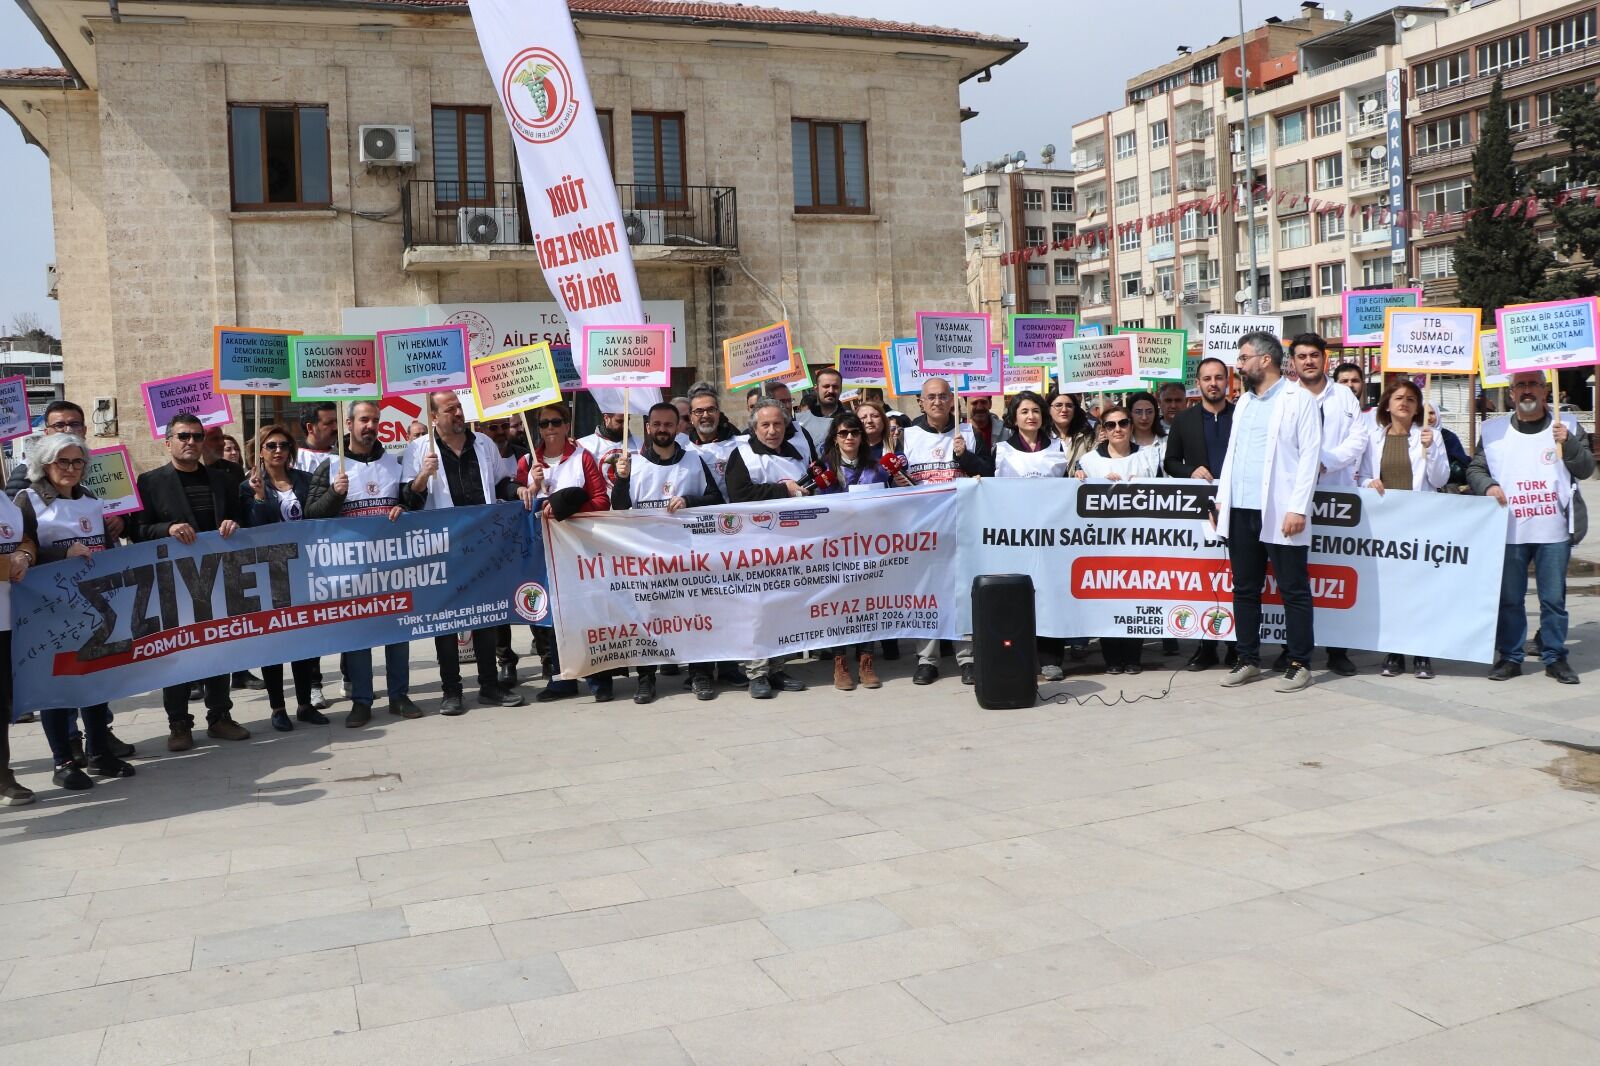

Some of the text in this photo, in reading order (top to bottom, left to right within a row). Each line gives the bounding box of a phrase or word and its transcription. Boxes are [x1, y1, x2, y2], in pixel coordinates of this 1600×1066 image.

[1539, 312, 1551, 321] BİR
[1572, 318, 1586, 327] BİR
[1209, 323, 1241, 334] SAĞLIK
[1423, 318, 1441, 328] TTB
[225, 337, 258, 346] AKADEMİK
[503, 330, 538, 346] AİLE
[635, 335, 648, 344] BİR
[1410, 331, 1453, 341] SUSMADI
[1514, 329, 1584, 344] HEKİMLİK ORTAMI
[398, 336, 449, 350] İYİ HEKİMLİK
[936, 344, 973, 353] İSTİYORUZ!
[1079, 343, 1113, 351] HALKLARIN
[1531, 341, 1567, 352] MÜMKÜN
[234, 347, 273, 356] DEMOKRATİK
[304, 346, 367, 356] SAĞLIĞIN YOLU
[598, 348, 619, 356] HALK
[905, 346, 916, 355] İYİ
[1396, 344, 1465, 355] SUSMAYACAK
[231, 356, 251, 364] ÖZERK
[407, 351, 442, 361] YAPMAK
[306, 358, 366, 368] DEMOKRASİ VE
[404, 361, 447, 374] İSTİYORUZ
[497, 357, 529, 370] DAKİKADA
[602, 359, 651, 367] SORUNUDUR
[1083, 360, 1112, 368] HAKKININ
[480, 370, 509, 385] HEKİMLİK
[501, 374, 534, 389] DAKİKADA
[199, 381, 210, 390] DE
[518, 382, 541, 393] OLMAZ
[161, 391, 213, 409] BEDENİMİZ DE
[1517, 479, 1548, 491] TÜRK
[1085, 489, 1202, 514] EMEĞİMİZ,
[1514, 504, 1557, 518] BİRLİĞİ
[305, 527, 449, 568] YÖNETMELİĞİNİ
[982, 523, 1469, 568] HALKIN SAĞLIK HAKKI, EMOKRASİ İÇİN
[577, 531, 938, 580] İYİ HEKİMLİK YAPMAK İSTİYORUZ!
[610, 580, 648, 592] ADALETİN
[650, 577, 679, 589] HAKİM
[682, 573, 720, 586] OLDUĞU,
[722, 571, 744, 583] LAİK,
[746, 566, 804, 582] DEMOKRATİK,
[832, 561, 860, 573] İÇİNDE
[864, 559, 877, 569] BİR
[880, 556, 909, 568] ÜLKEDE
[1080, 569, 1203, 591] ANKARA'YA
[309, 561, 448, 602] İSTEMİYORUZ!
[634, 569, 884, 602] EMEĞİMİZİN VE MESLEĞİMİZİN DEĞER GÖRMESİNİ İSTİYORUZ
[810, 594, 938, 618] BEYAZ BULUŞMA
[1136, 605, 1163, 615] TÜRK
[397, 614, 424, 626] TÜRK
[425, 604, 475, 622] TABİPLERİ
[477, 599, 509, 615] BİRLİĞİ
[845, 616, 854, 624] 14
[856, 613, 879, 623] MART
[882, 611, 904, 620] 2026
[411, 625, 434, 636] AİLE
[435, 615, 482, 632] HEKİMLİĞİ
[483, 611, 507, 624] KOLU
[1113, 615, 1164, 625] TABİPLERİ
[132, 595, 408, 660] FORMÜL DEĞİL, AİLE HEKİMİYİZ
[587, 614, 713, 644] BEYAZ YÜRÜYÜŞ
[778, 620, 939, 645] HACETTEPE ÜNİVERSİTESİ TIP FAKÜLTESİ
[1127, 625, 1164, 635] BİRLİĞİ
[589, 638, 658, 655] 11-14 MART 2026
[591, 648, 676, 666] DİYARBAKIR-ANKARA
